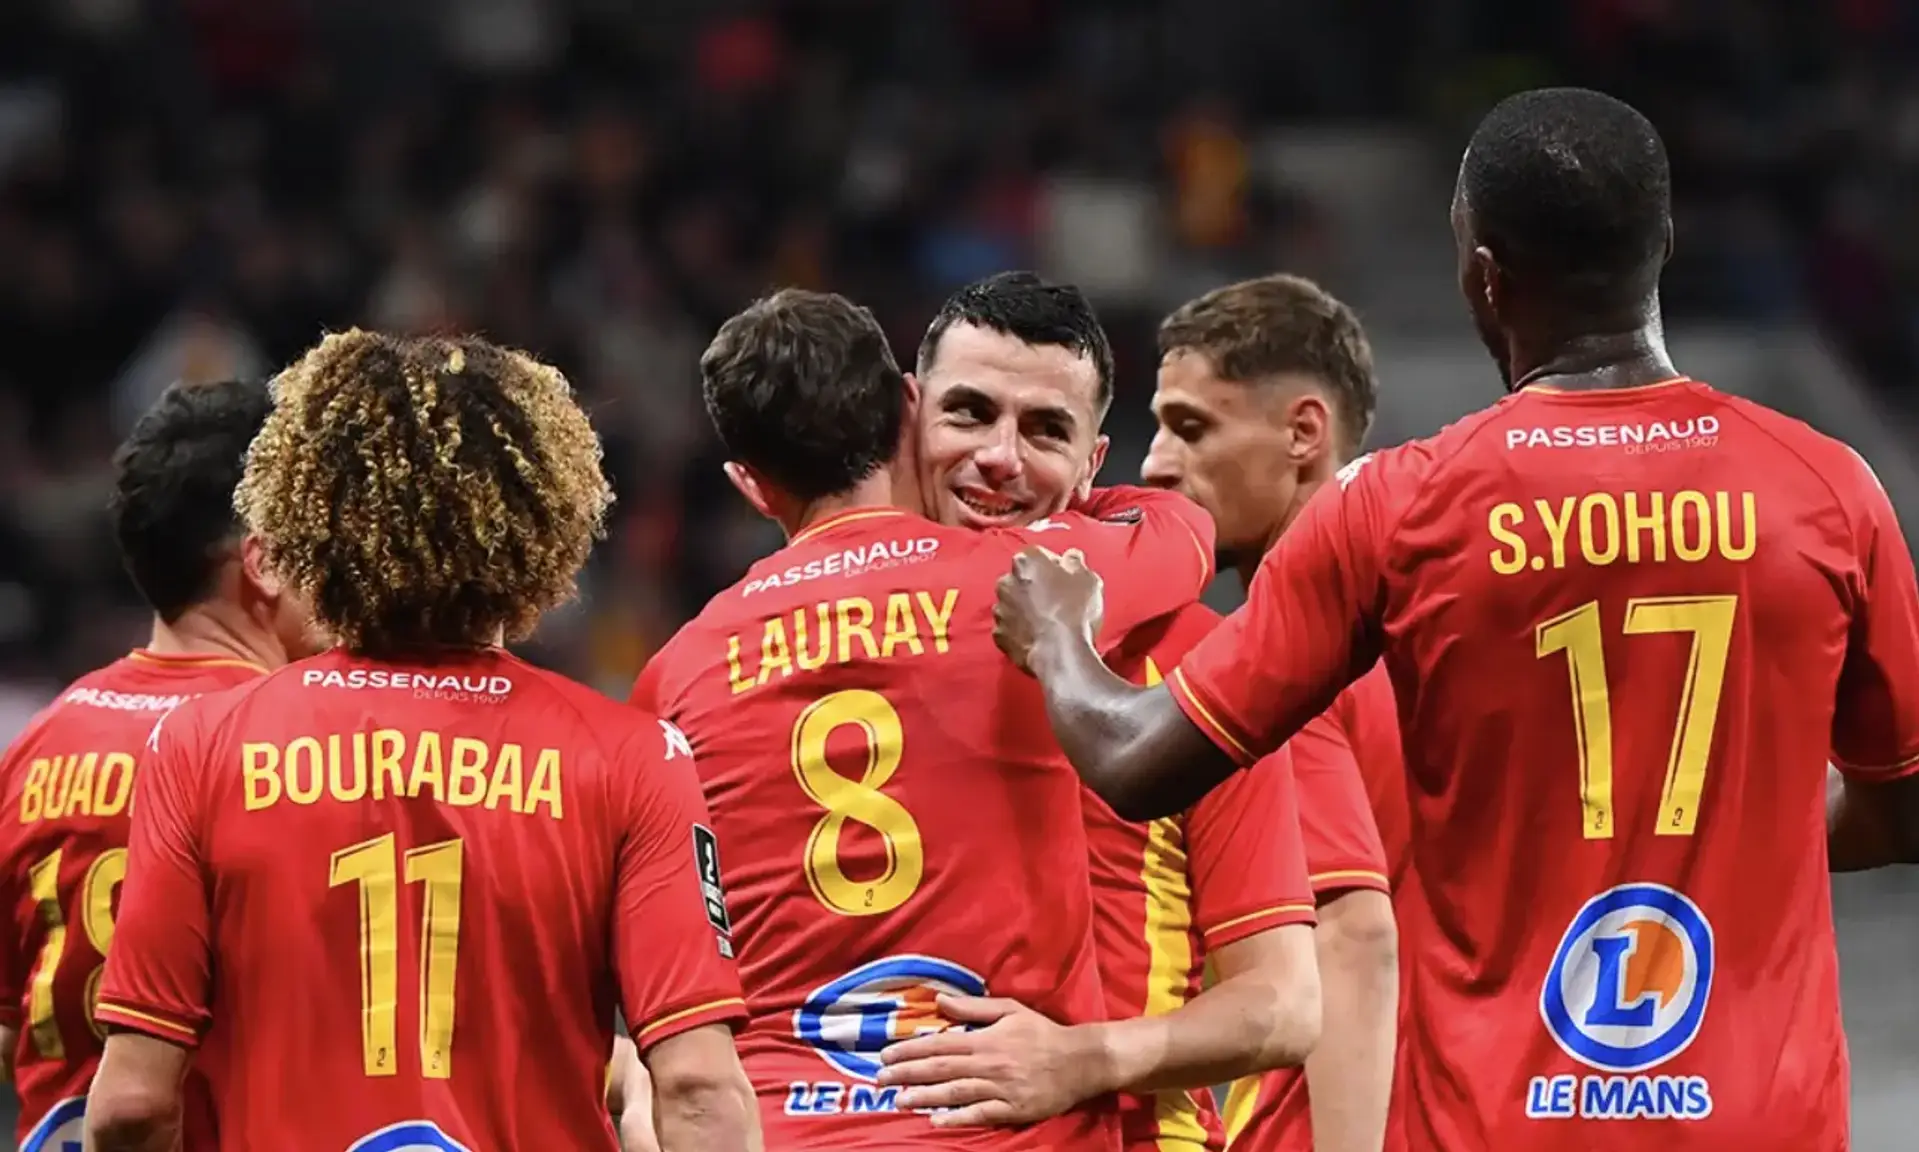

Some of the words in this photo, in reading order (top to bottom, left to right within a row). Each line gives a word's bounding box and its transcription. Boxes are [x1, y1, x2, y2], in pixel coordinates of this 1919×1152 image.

[1506, 416, 1720, 449] PASSENAUD
[1625, 441, 1682, 455] DEPUIS
[1685, 435, 1720, 449] 1907
[1489, 490, 1756, 574] S.YOHOU
[742, 537, 940, 598] PASSENAUD
[727, 589, 960, 695] LAURAY
[65, 687, 202, 711] PASSENA
[303, 670, 512, 694] PASSENAUD
[413, 689, 469, 702] DEPUIS
[1536, 595, 1738, 839] 17
[20, 752, 137, 824] BUAD
[243, 730, 562, 819] BOURABAA
[792, 690, 924, 916] 8
[329, 832, 464, 1079] 11
[1583, 934, 1656, 1027] L
[788, 1082, 842, 1114] LE
[1531, 1078, 1574, 1114] LE
[1583, 1079, 1709, 1116] MANS
